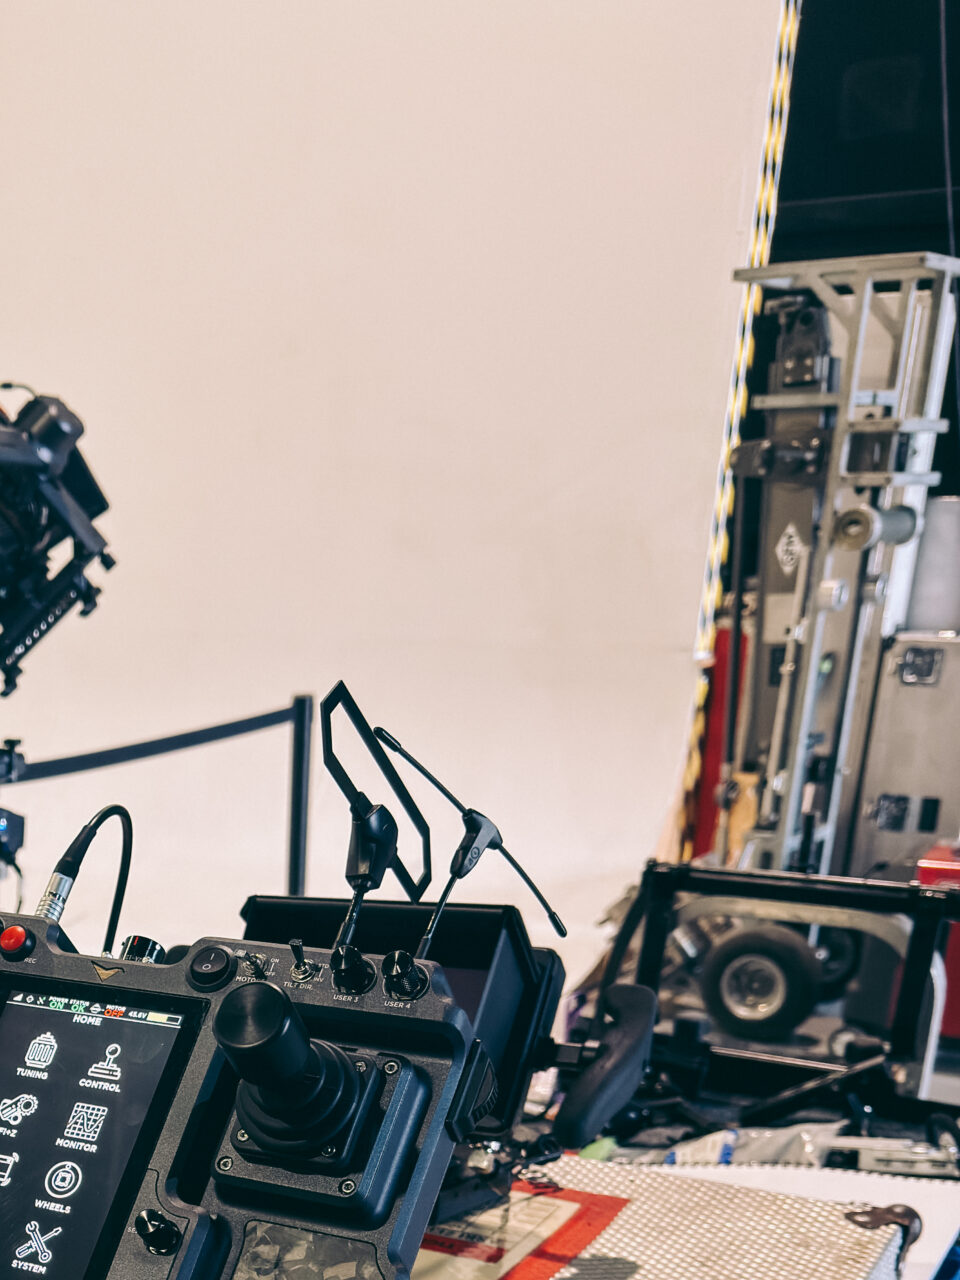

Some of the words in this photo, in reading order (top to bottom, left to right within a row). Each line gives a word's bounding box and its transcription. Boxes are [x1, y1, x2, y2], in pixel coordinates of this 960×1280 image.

[48, 996, 69, 1004] POWER
[69, 999, 90, 1007] STATUS
[333, 994, 353, 1002] USER
[49, 1001, 64, 1010] ON
[71, 1004, 86, 1013] OK
[106, 1004, 126, 1012] MOTOR
[384, 1001, 404, 1009] USER
[104, 1009, 124, 1018] OFF
[72, 1014, 103, 1026] HOME
[16, 1067, 48, 1080] TUNING
[79, 1078, 121, 1093] CONTROL
[55, 1138, 98, 1153] MONITOR
[34, 1199, 71, 1214] WHEELS
[11, 1259, 47, 1274] SYSTEM
